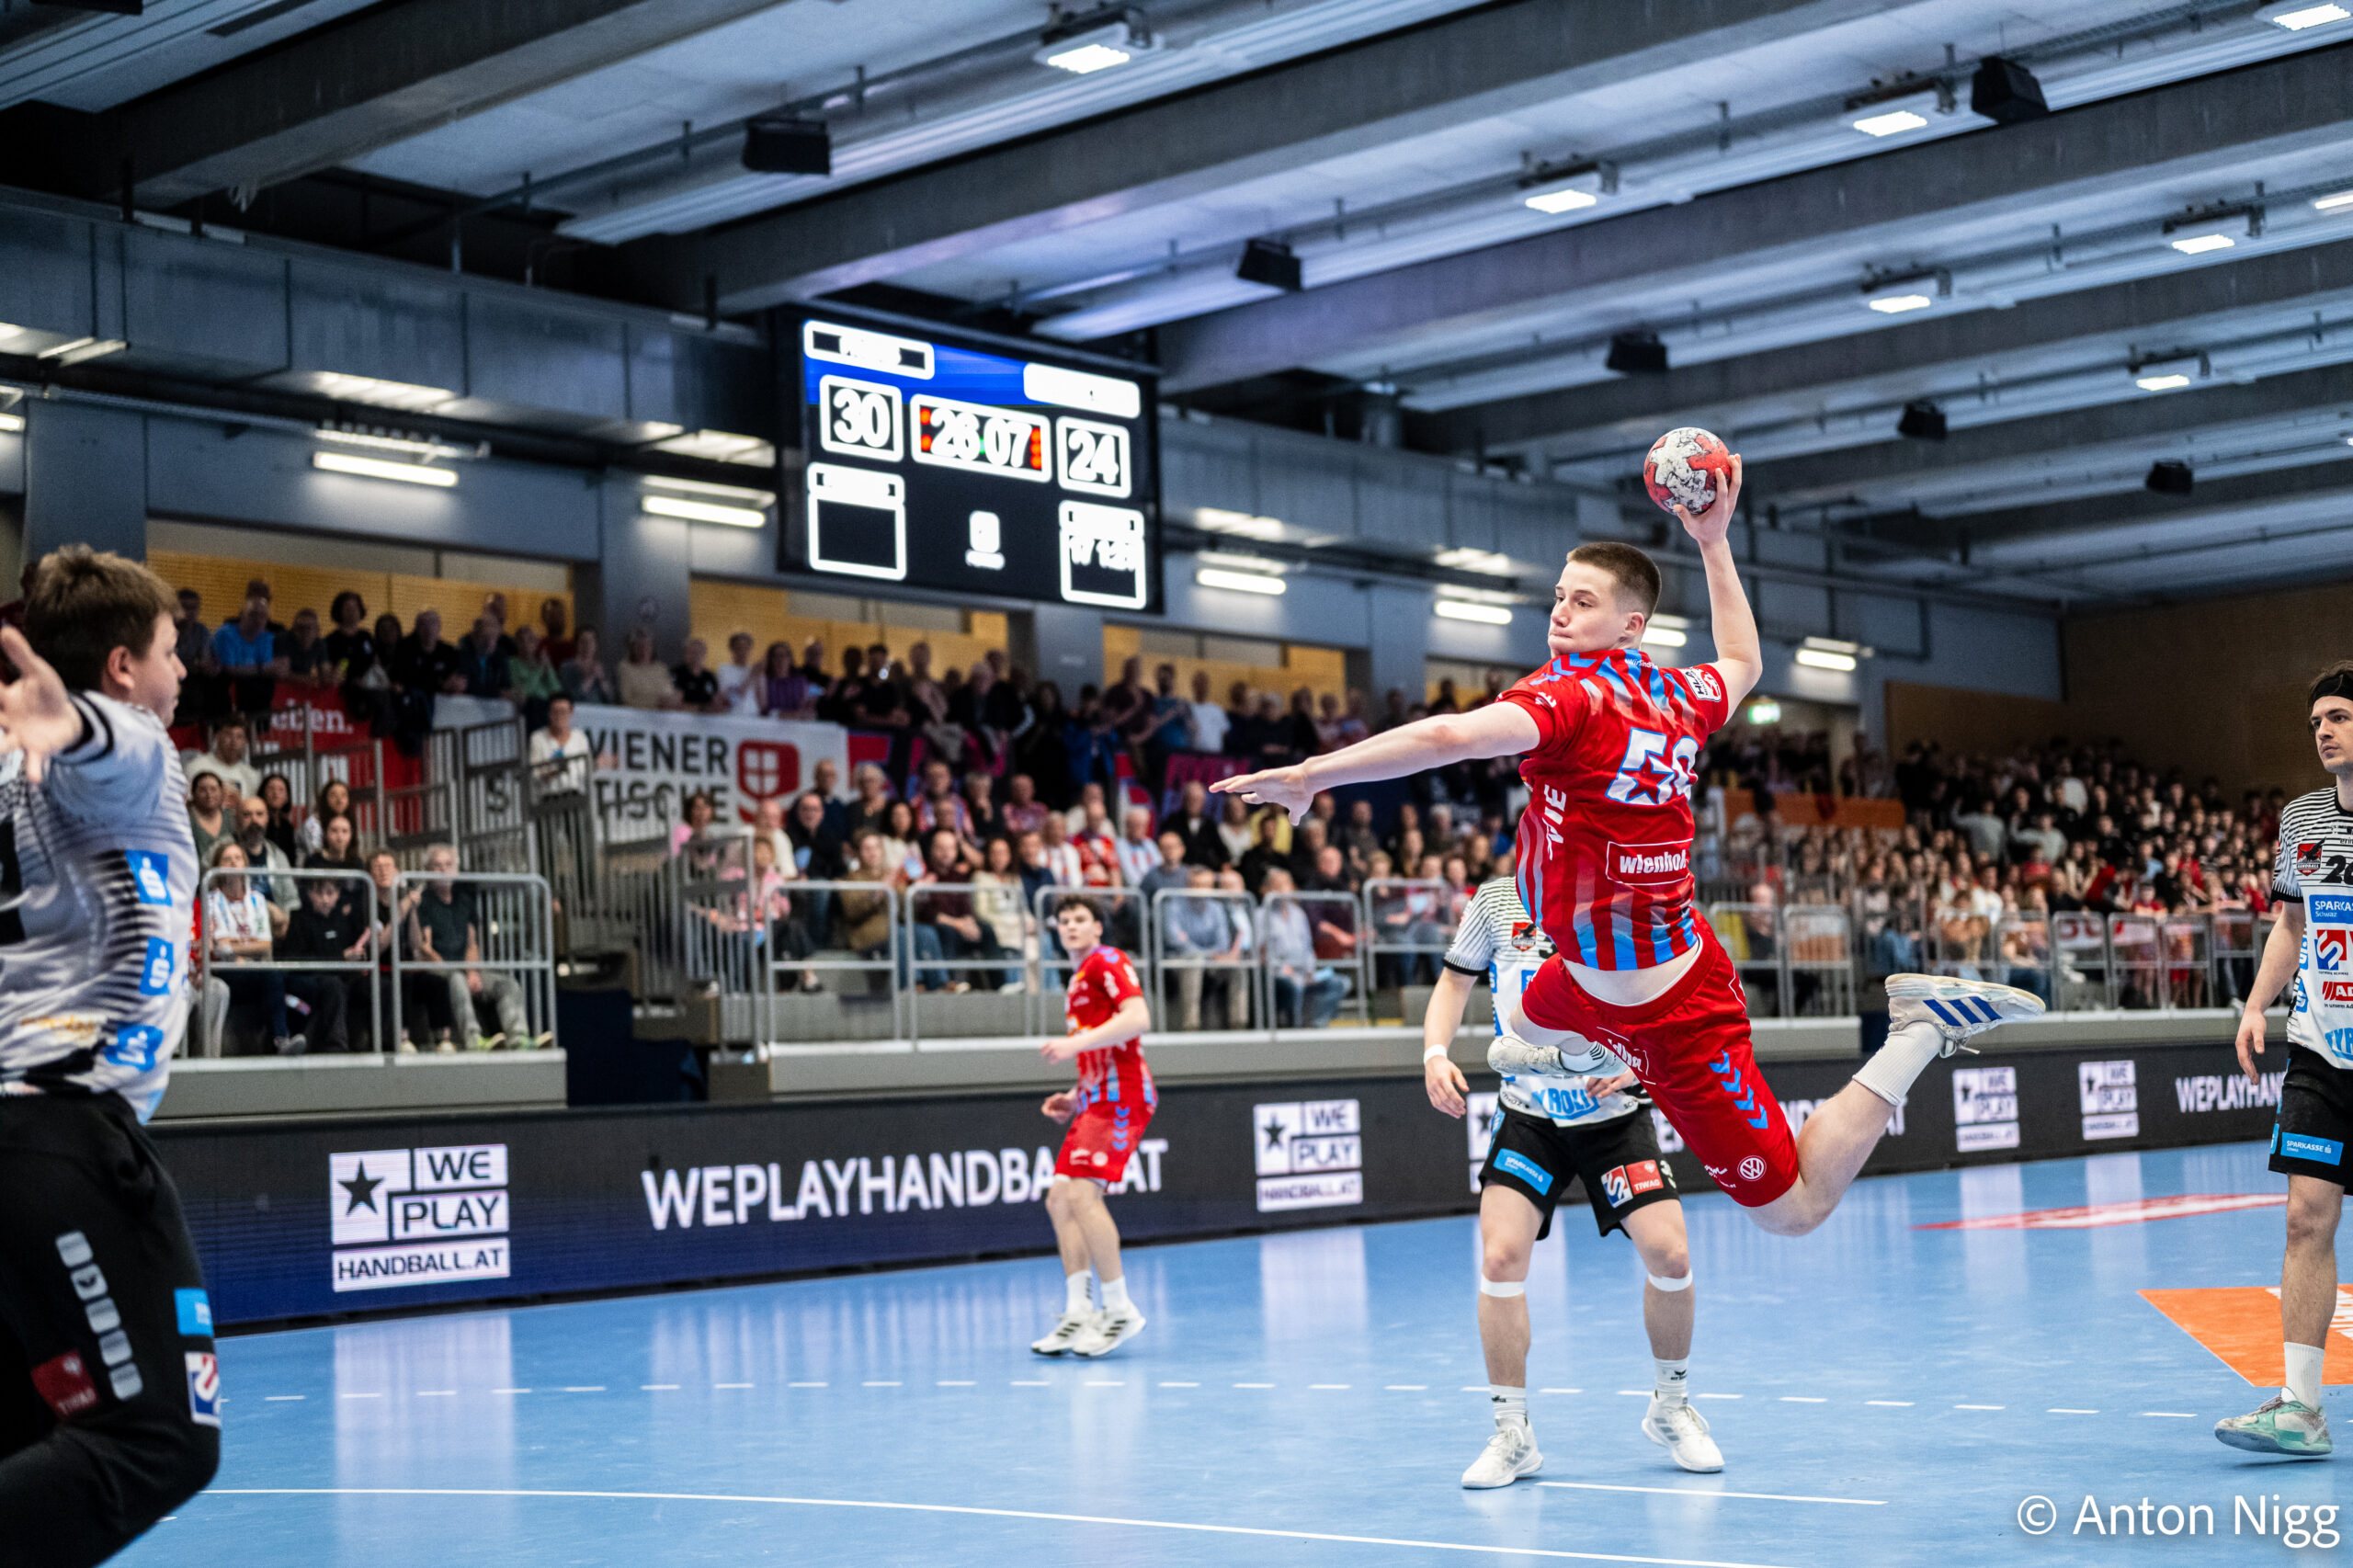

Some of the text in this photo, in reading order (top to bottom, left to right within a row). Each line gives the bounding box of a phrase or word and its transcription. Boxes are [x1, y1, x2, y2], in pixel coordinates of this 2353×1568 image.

[833, 388, 891, 448] 30
[1067, 428, 1120, 484] 24
[2314, 900, 2353, 912] SPARKA
[2175, 1071, 2286, 1114] WEPLAYHAN
[2286, 1140, 2325, 1153] SPARKASSE
[427, 1150, 491, 1182] WE
[1634, 1178, 1661, 1191] TIWAG
[402, 1196, 499, 1233] PLAY
[337, 1247, 504, 1281] HANDBALL.AT
